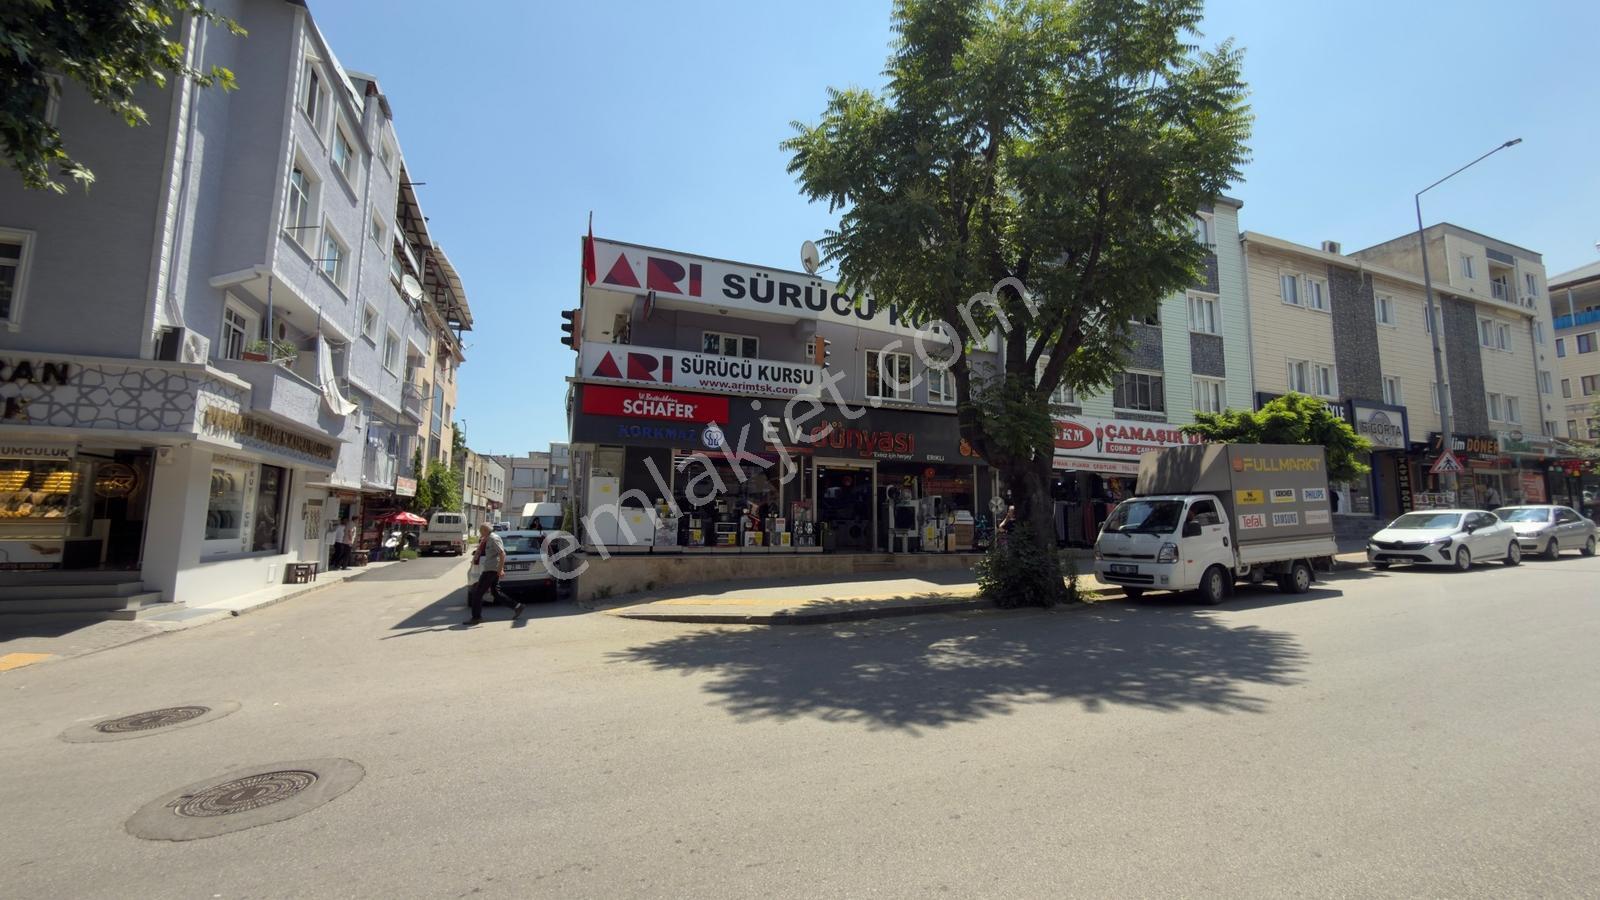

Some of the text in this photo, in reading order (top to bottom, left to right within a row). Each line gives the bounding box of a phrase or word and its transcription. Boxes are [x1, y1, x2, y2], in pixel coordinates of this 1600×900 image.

[602, 252, 702, 298] ARI
[722, 272, 876, 321] SÜRÜCÜ
[592, 350, 814, 385] ARI SÜRÜCÜ KURSU
[699, 378, 798, 395] www.arimtsk.com
[623, 399, 694, 419] SCHAFER
[1105, 424, 1184, 446] ÇAMAŞIR
[1243, 457, 1320, 472] FULLMARKT
[1242, 515, 1263, 529] Tefal
[1274, 513, 1297, 525] SAMSUNG
